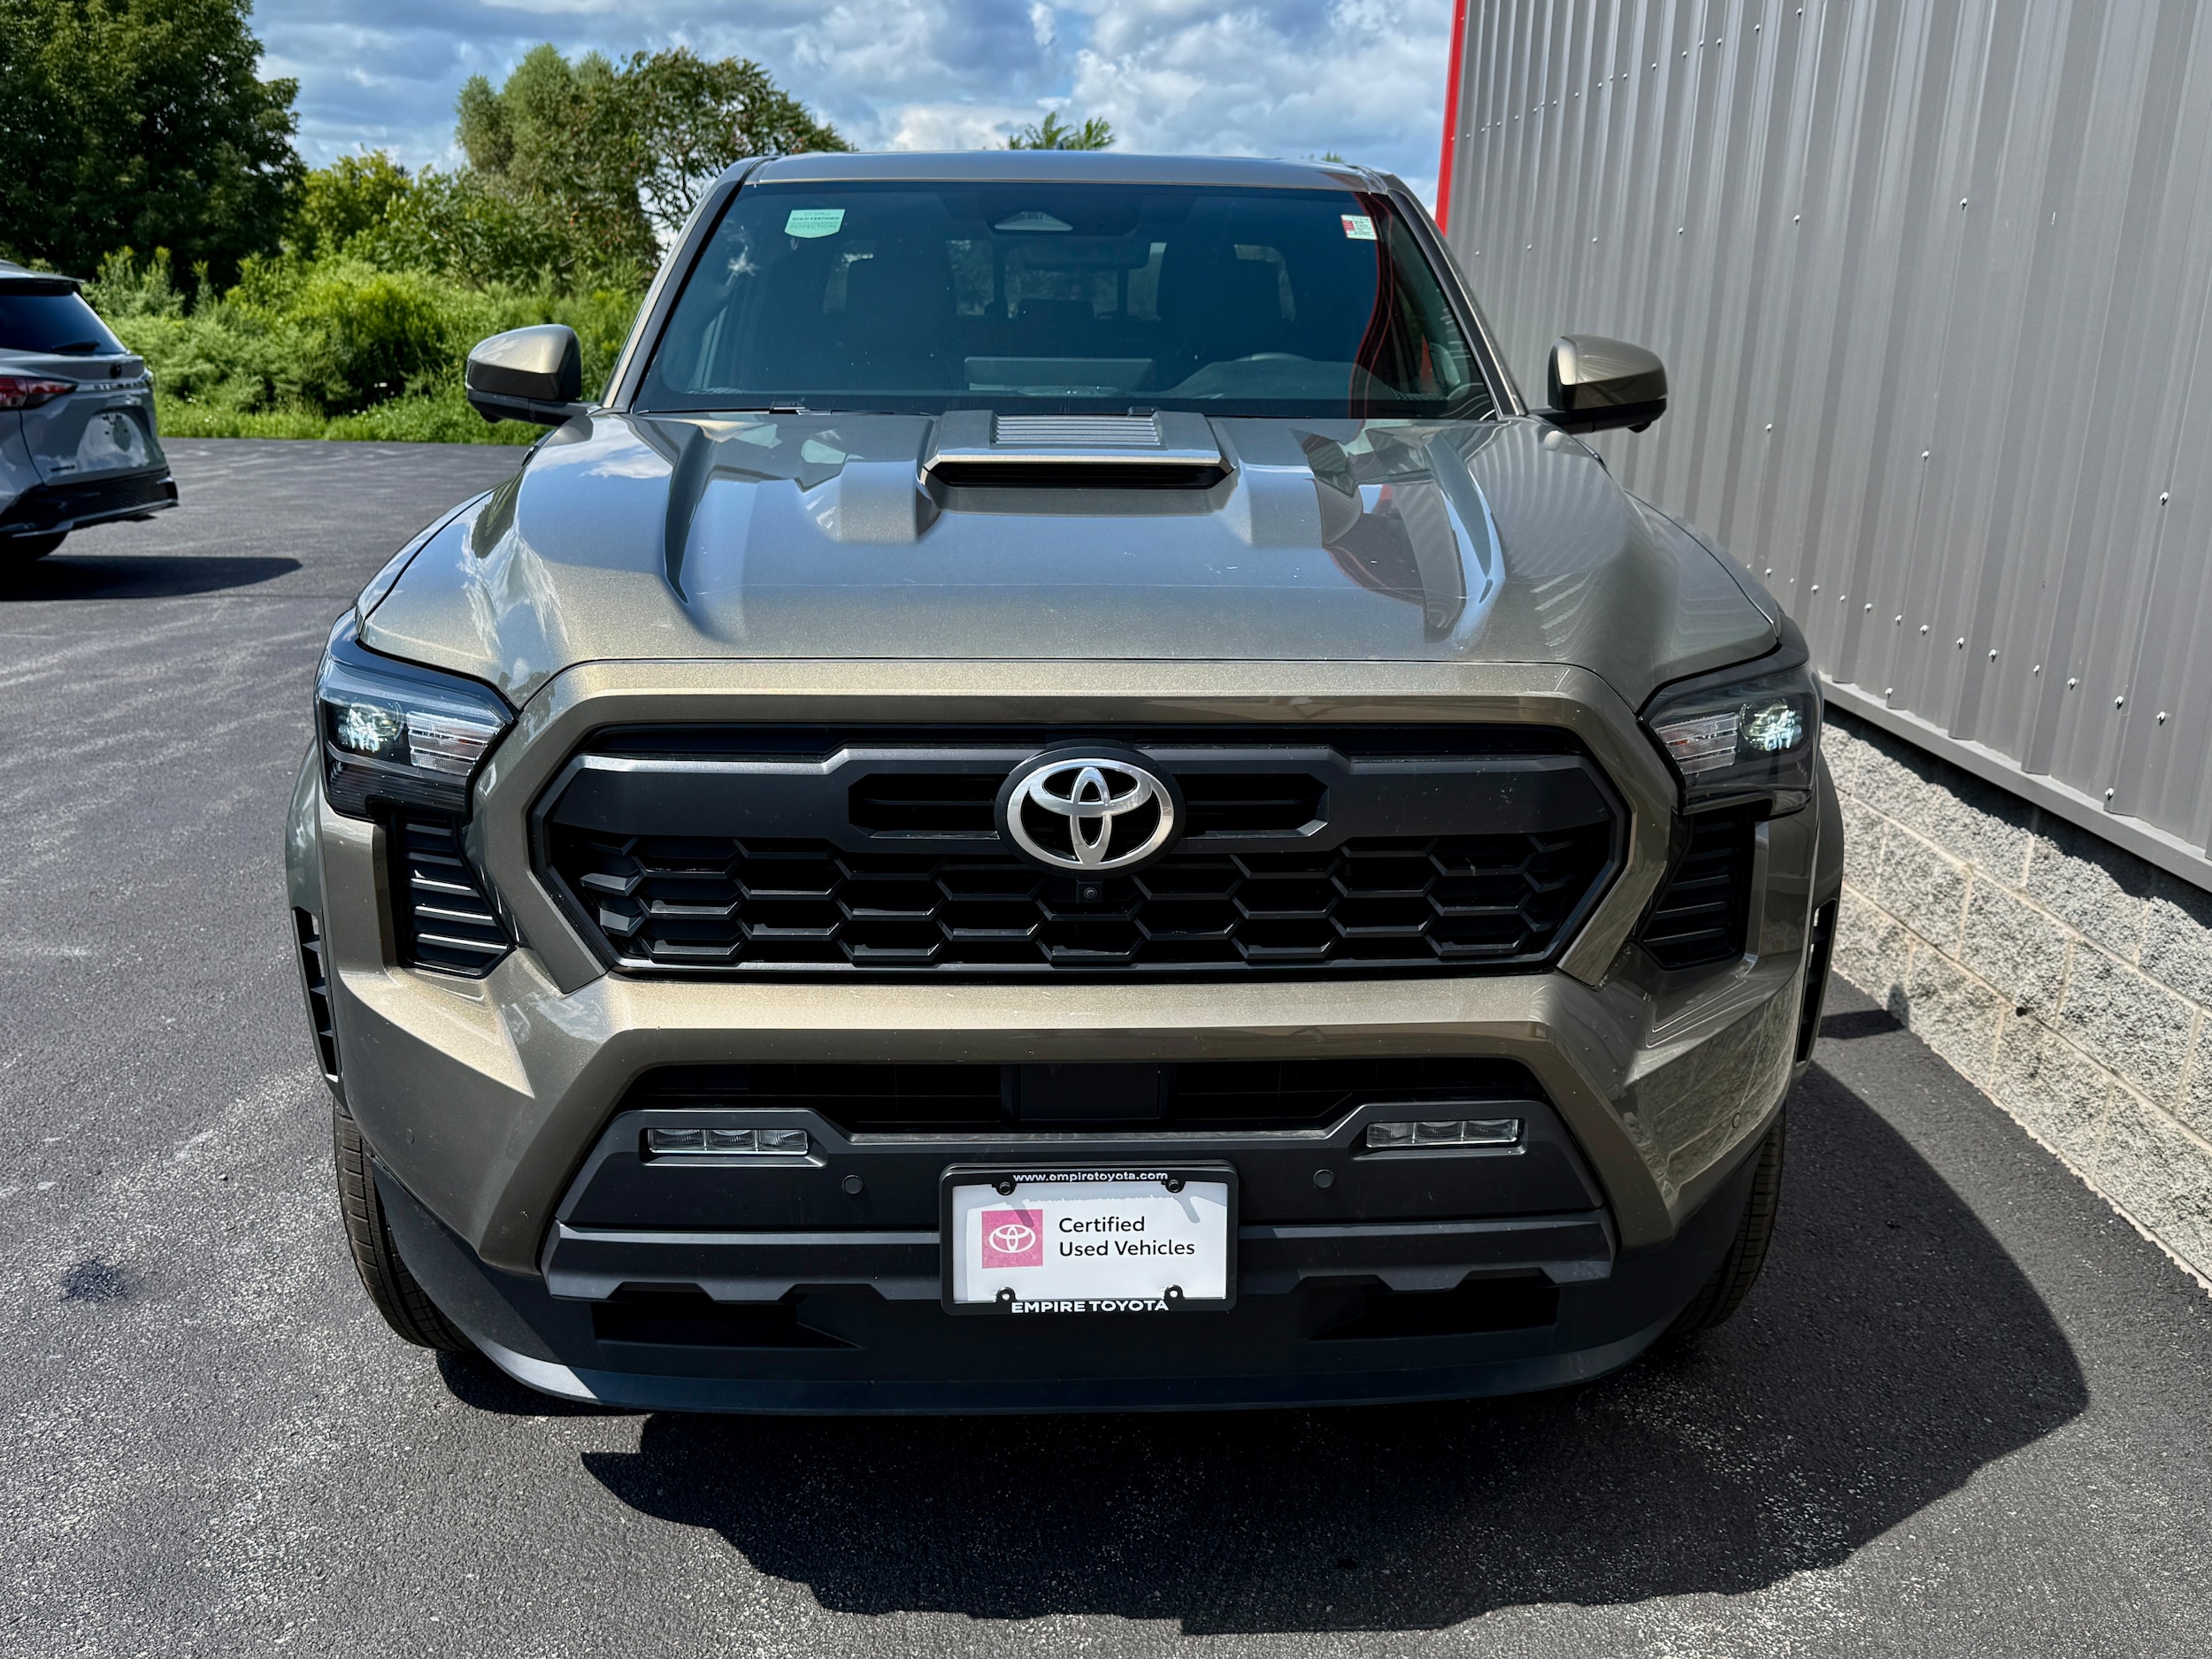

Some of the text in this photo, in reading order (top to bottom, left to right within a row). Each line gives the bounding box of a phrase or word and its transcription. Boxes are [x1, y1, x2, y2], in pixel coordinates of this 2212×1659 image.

[1013, 1171, 1168, 1182] www.empiretoyota.com
[1059, 1216, 1145, 1233] Certified
[1060, 1239, 1195, 1256] Used Vehicles
[1011, 1300, 1169, 1313] EMPIRE TOYOTA
